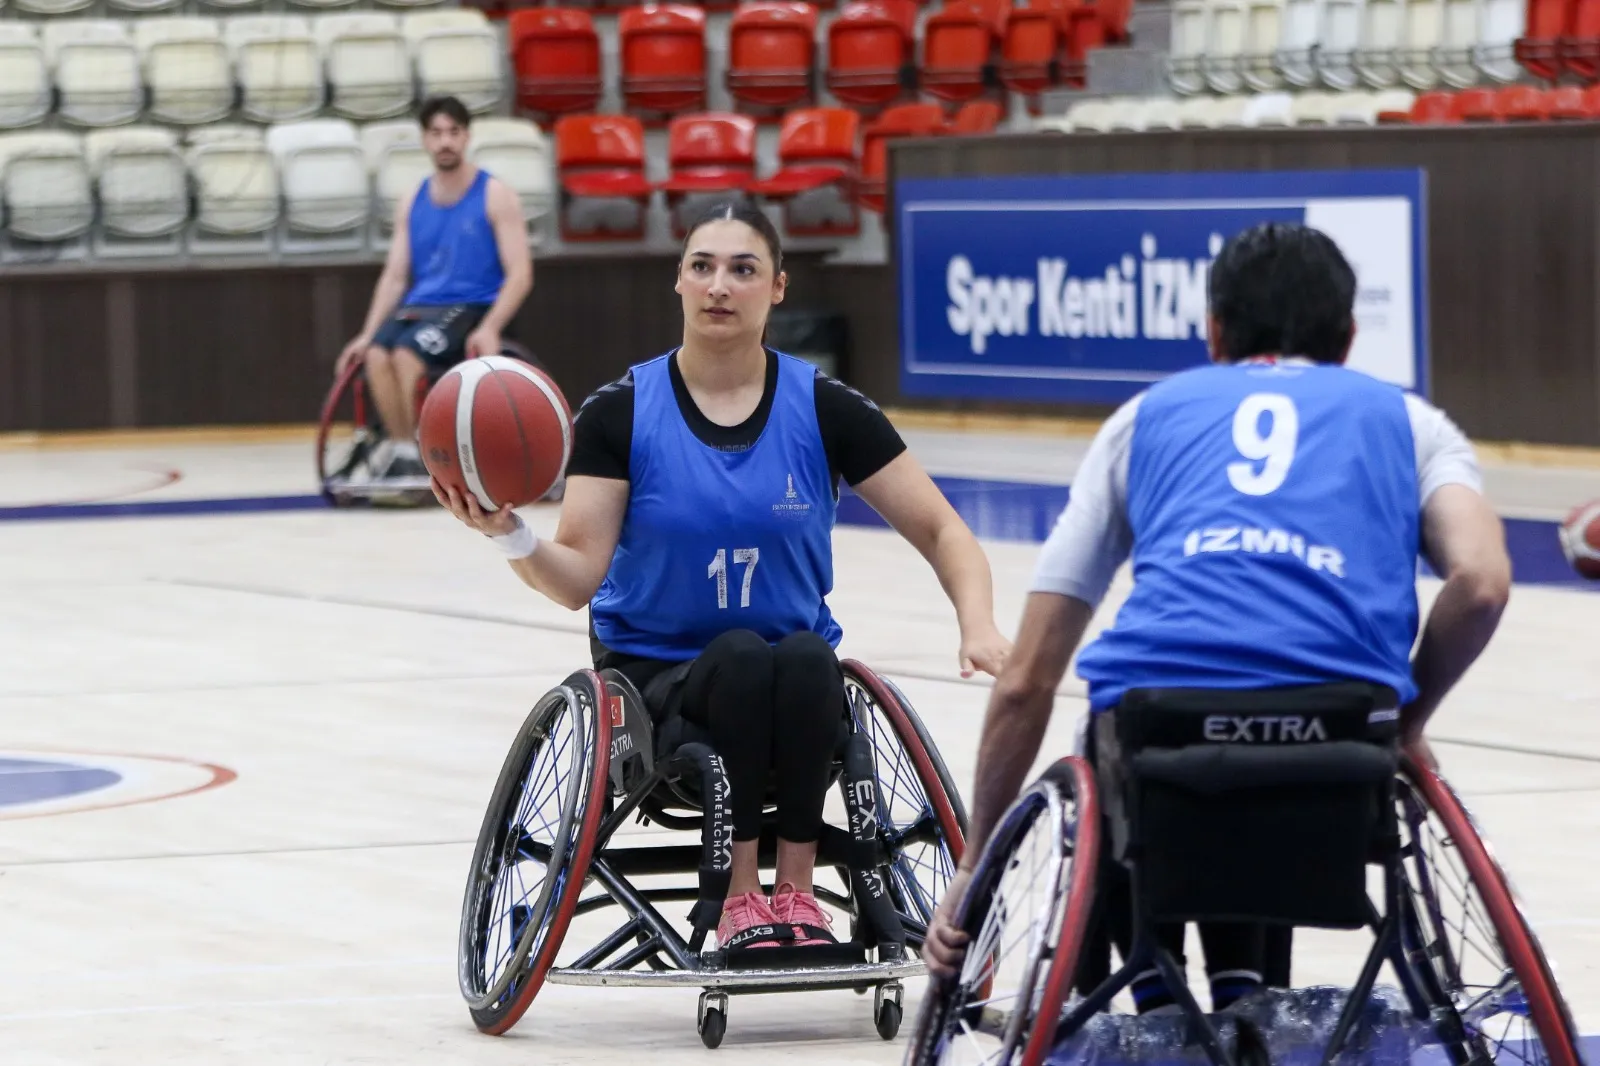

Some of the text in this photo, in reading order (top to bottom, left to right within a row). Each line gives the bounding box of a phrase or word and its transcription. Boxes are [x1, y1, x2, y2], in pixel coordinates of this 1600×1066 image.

[946, 254, 1034, 355] Spor
[1037, 253, 1137, 339] Kenti
[1226, 391, 1299, 497] 9
[707, 547, 759, 609] 17
[1203, 714, 1326, 742] EXTRA
[708, 754, 720, 774] THE
[847, 782, 856, 806] THE
